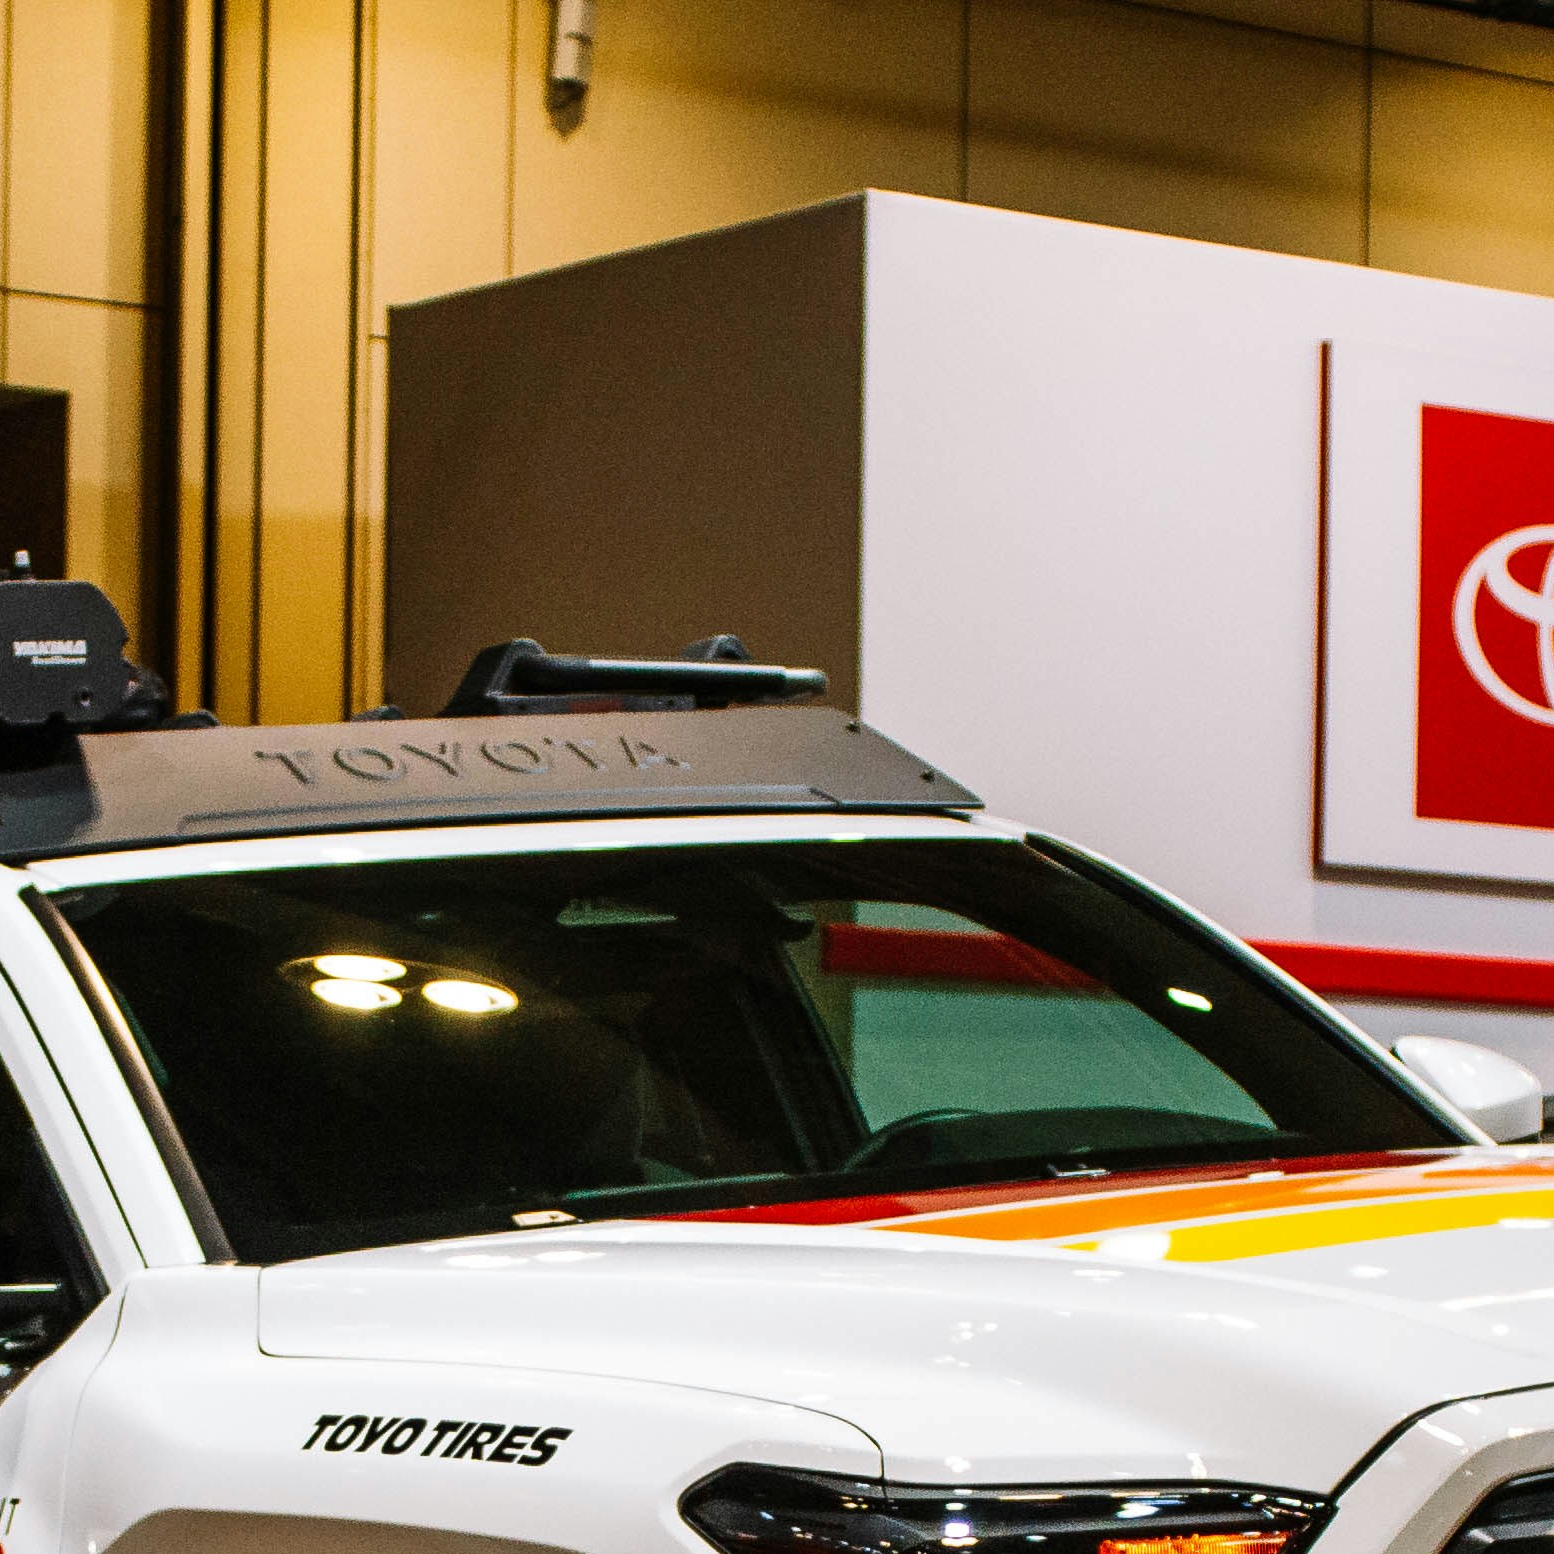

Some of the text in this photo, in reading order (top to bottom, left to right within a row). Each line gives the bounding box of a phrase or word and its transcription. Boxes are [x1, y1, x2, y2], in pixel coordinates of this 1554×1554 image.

[253, 736, 690, 785] TOYOTA
[301, 1414, 574, 1467] TOYO TIRES
